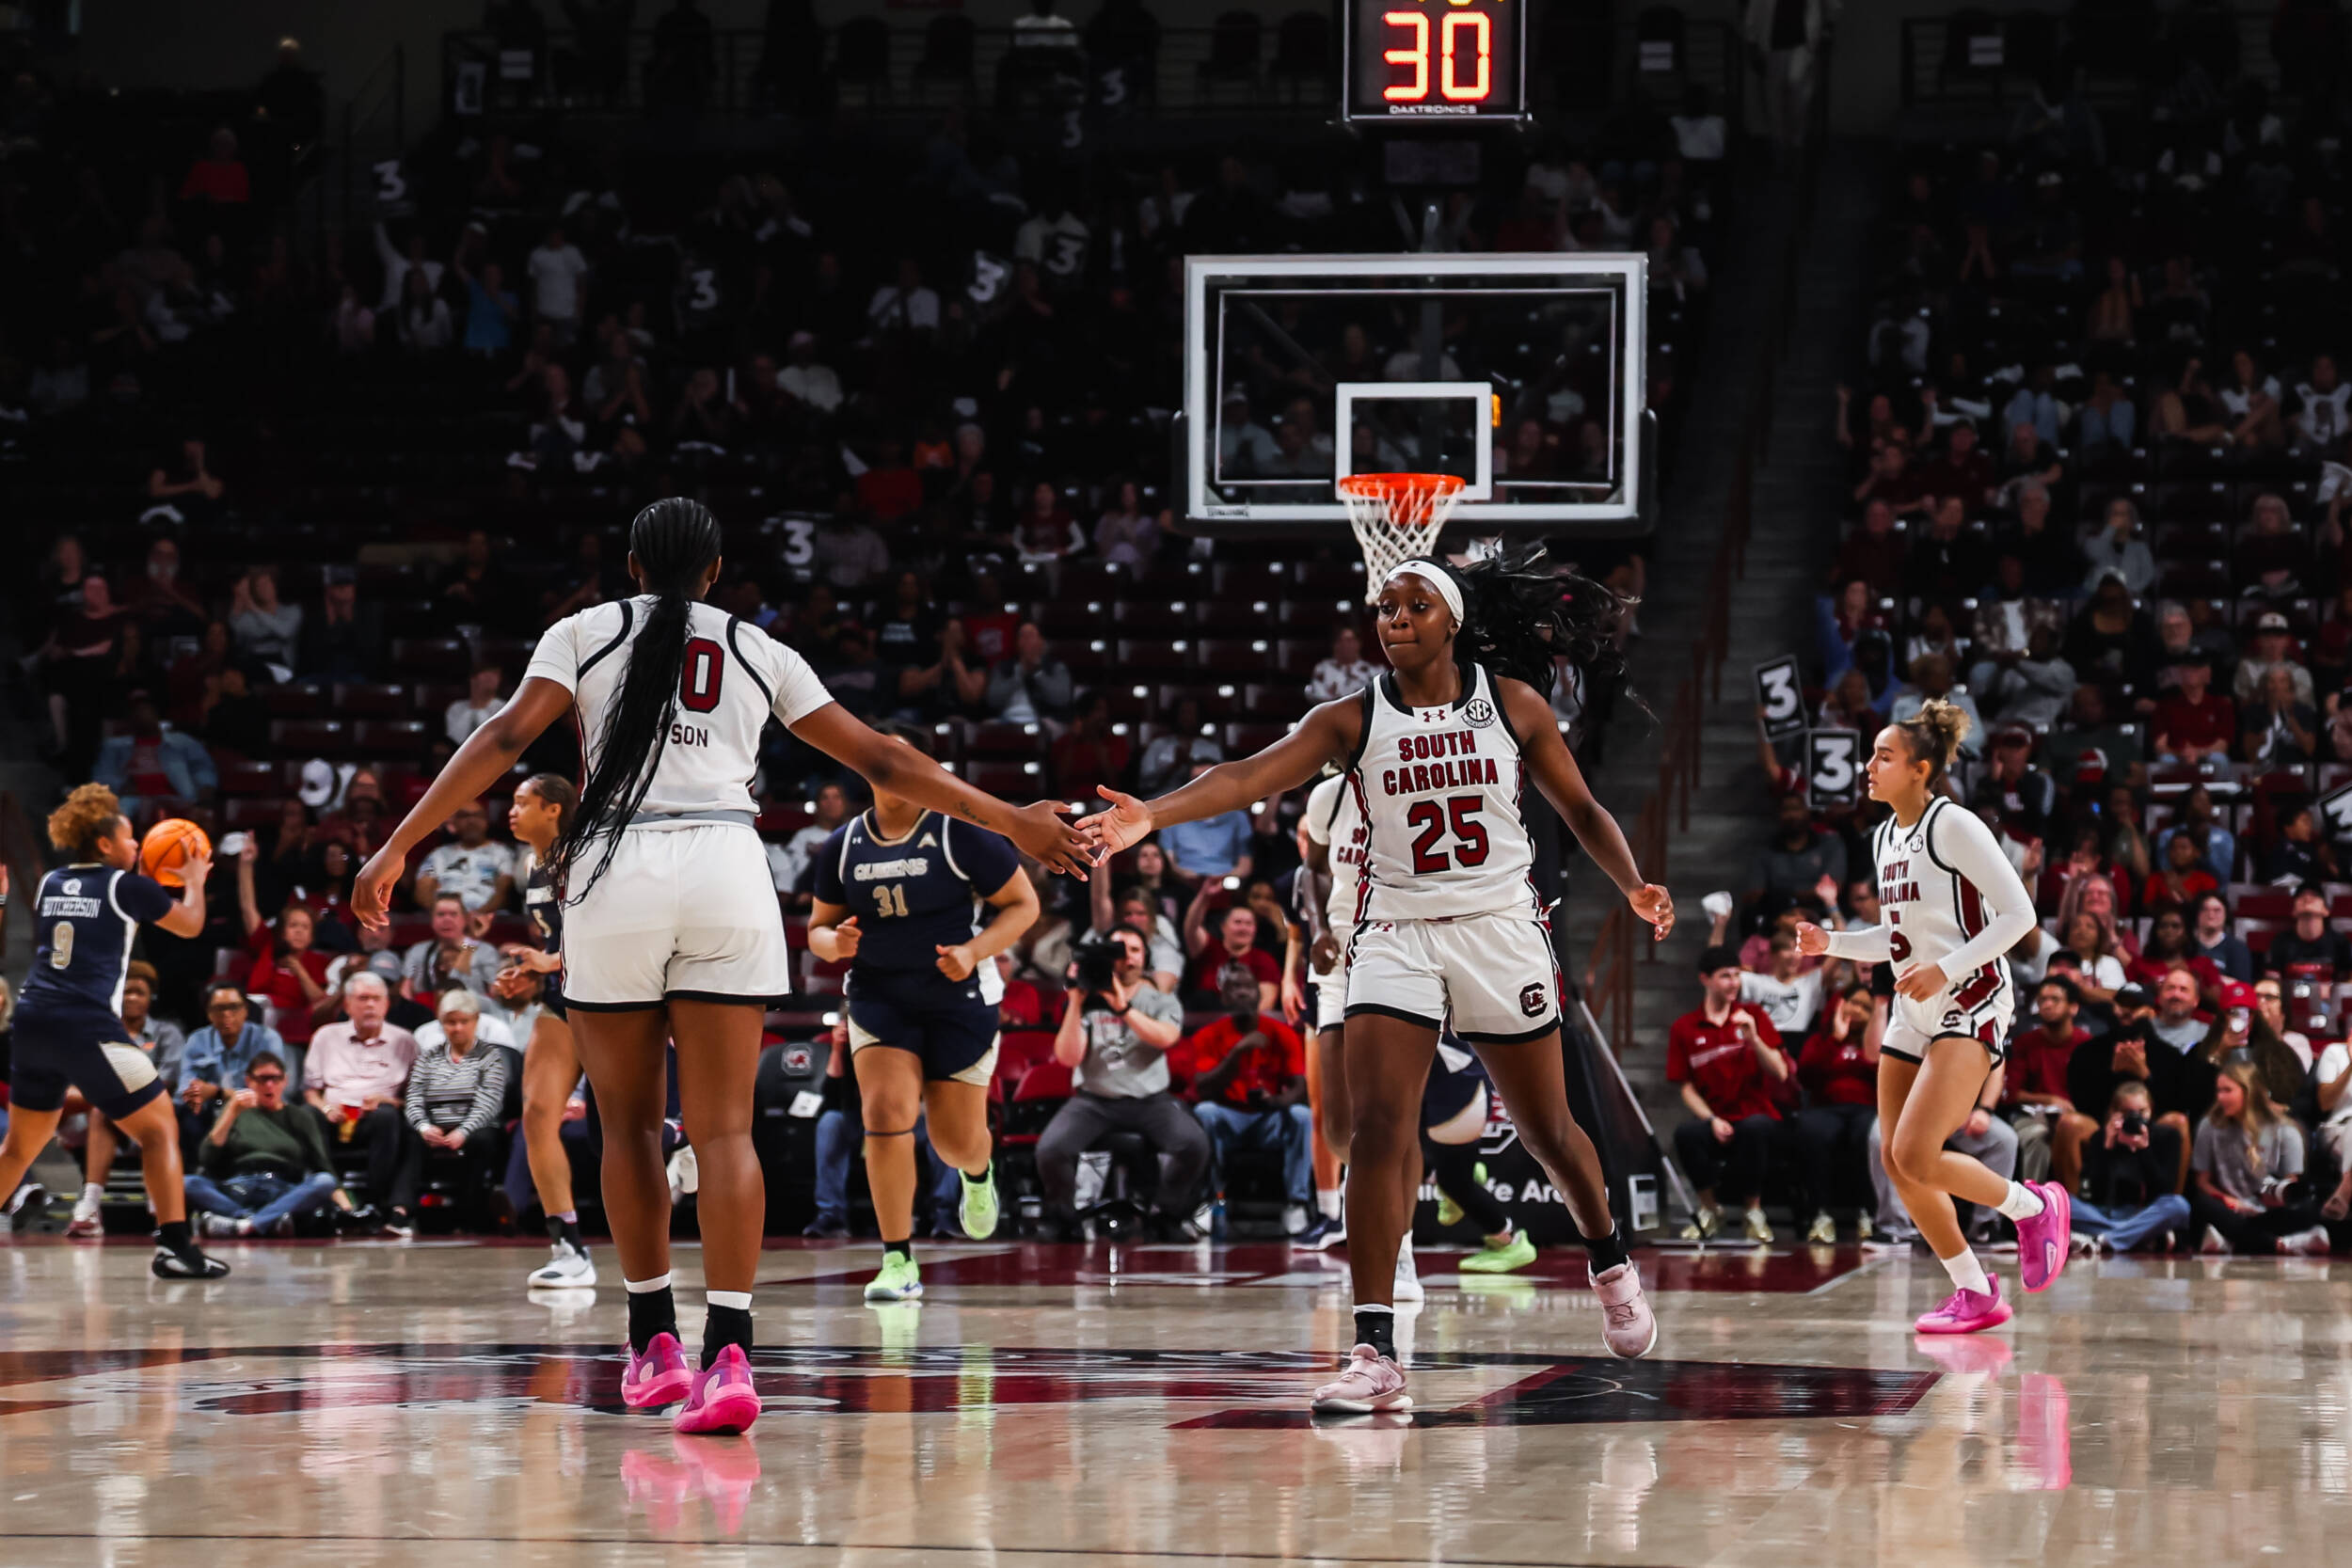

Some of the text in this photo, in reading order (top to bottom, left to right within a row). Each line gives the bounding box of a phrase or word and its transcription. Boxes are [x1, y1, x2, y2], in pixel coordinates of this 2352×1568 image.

[1383, 12, 1490, 102] 30
[1390, 105, 1477, 114] DAKTRONICS
[373, 159, 407, 200] 3
[967, 249, 1006, 302] 3
[1046, 238, 1084, 275] 3
[691, 268, 719, 310] 3
[782, 519, 815, 565] 3
[678, 636, 724, 713] 0
[1760, 664, 1797, 721] 3
[1467, 700, 1491, 721] SEC
[1398, 730, 1476, 762] SOUTH
[1812, 736, 1853, 792] 3
[1383, 758, 1499, 797] CAROLINA
[1406, 796, 1490, 875] 25
[872, 883, 911, 919] 31
[1889, 911, 1913, 963] 5
